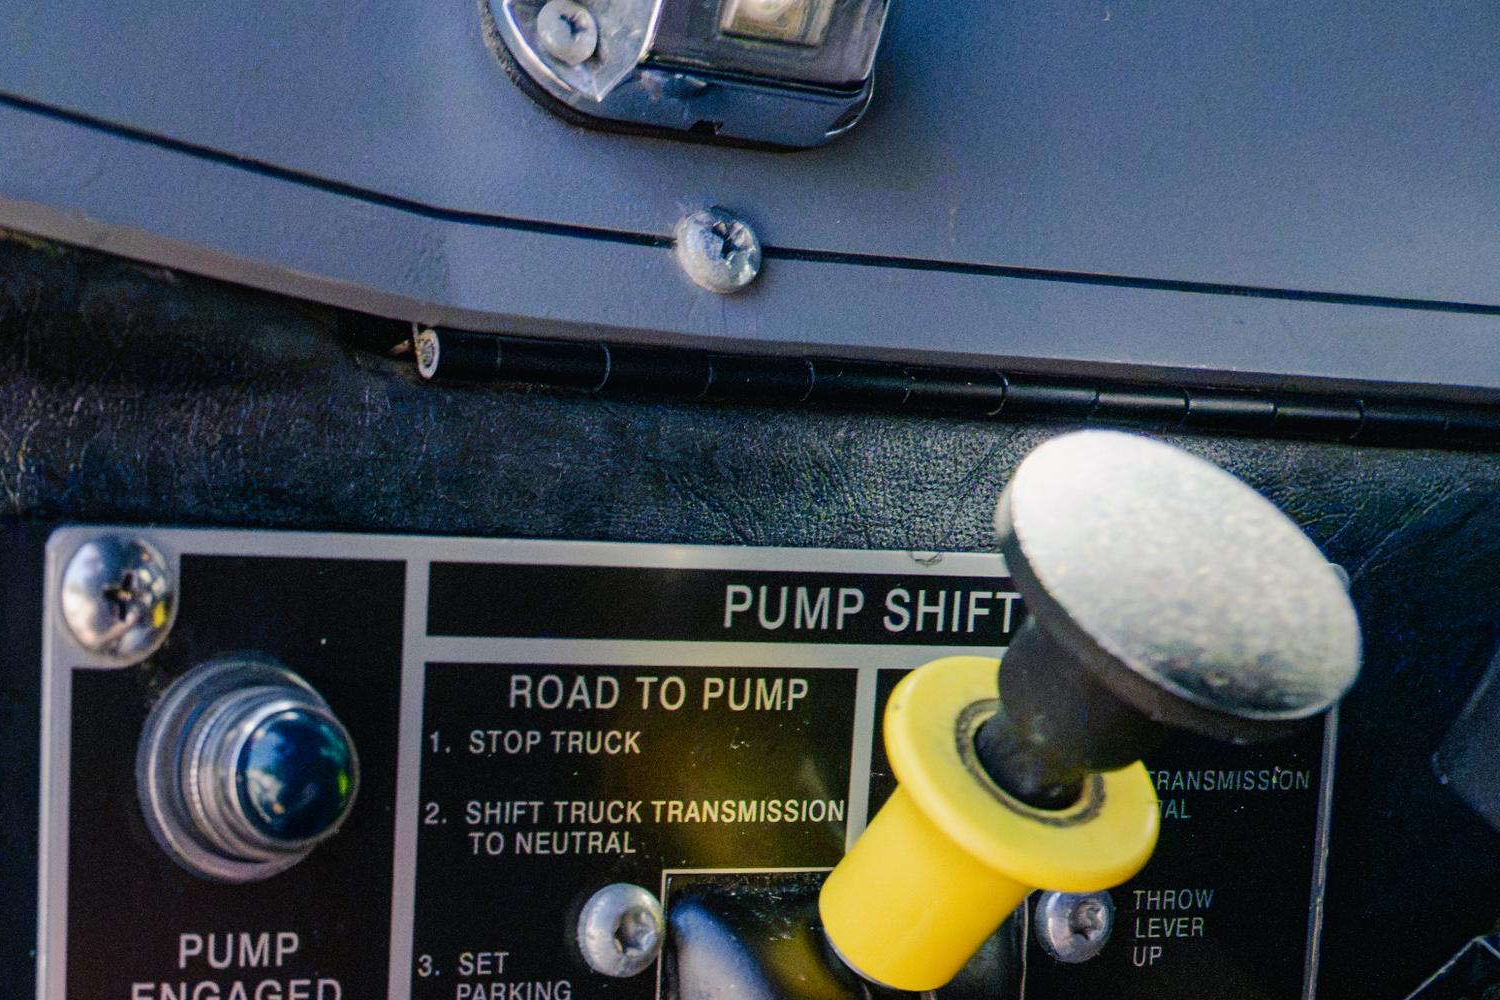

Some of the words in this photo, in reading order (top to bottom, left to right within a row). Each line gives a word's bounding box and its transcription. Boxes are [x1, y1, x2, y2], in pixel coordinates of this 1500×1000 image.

[724, 585, 864, 630] PUMP
[884, 588, 1022, 633] SHIFT
[510, 675, 619, 709] ROAD
[636, 677, 685, 711] TO
[703, 678, 808, 711] PUMP
[430, 731, 450, 752] 1.
[469, 730, 541, 754] STOP
[552, 730, 641, 754] TRUCK
[425, 802, 446, 824] 2.
[466, 801, 543, 824] SHIFT
[554, 800, 642, 823] TRUCK
[652, 800, 843, 823] TRANSMISSION
[469, 832, 504, 855] TO
[516, 831, 636, 854] NEUTRAL
[1133, 889, 1213, 910] THROW
[1135, 917, 1204, 938] LEVER
[179, 932, 298, 968] PUMP
[1133, 946, 1162, 967] UP
[418, 955, 440, 977] 3.
[459, 952, 509, 975] SET
